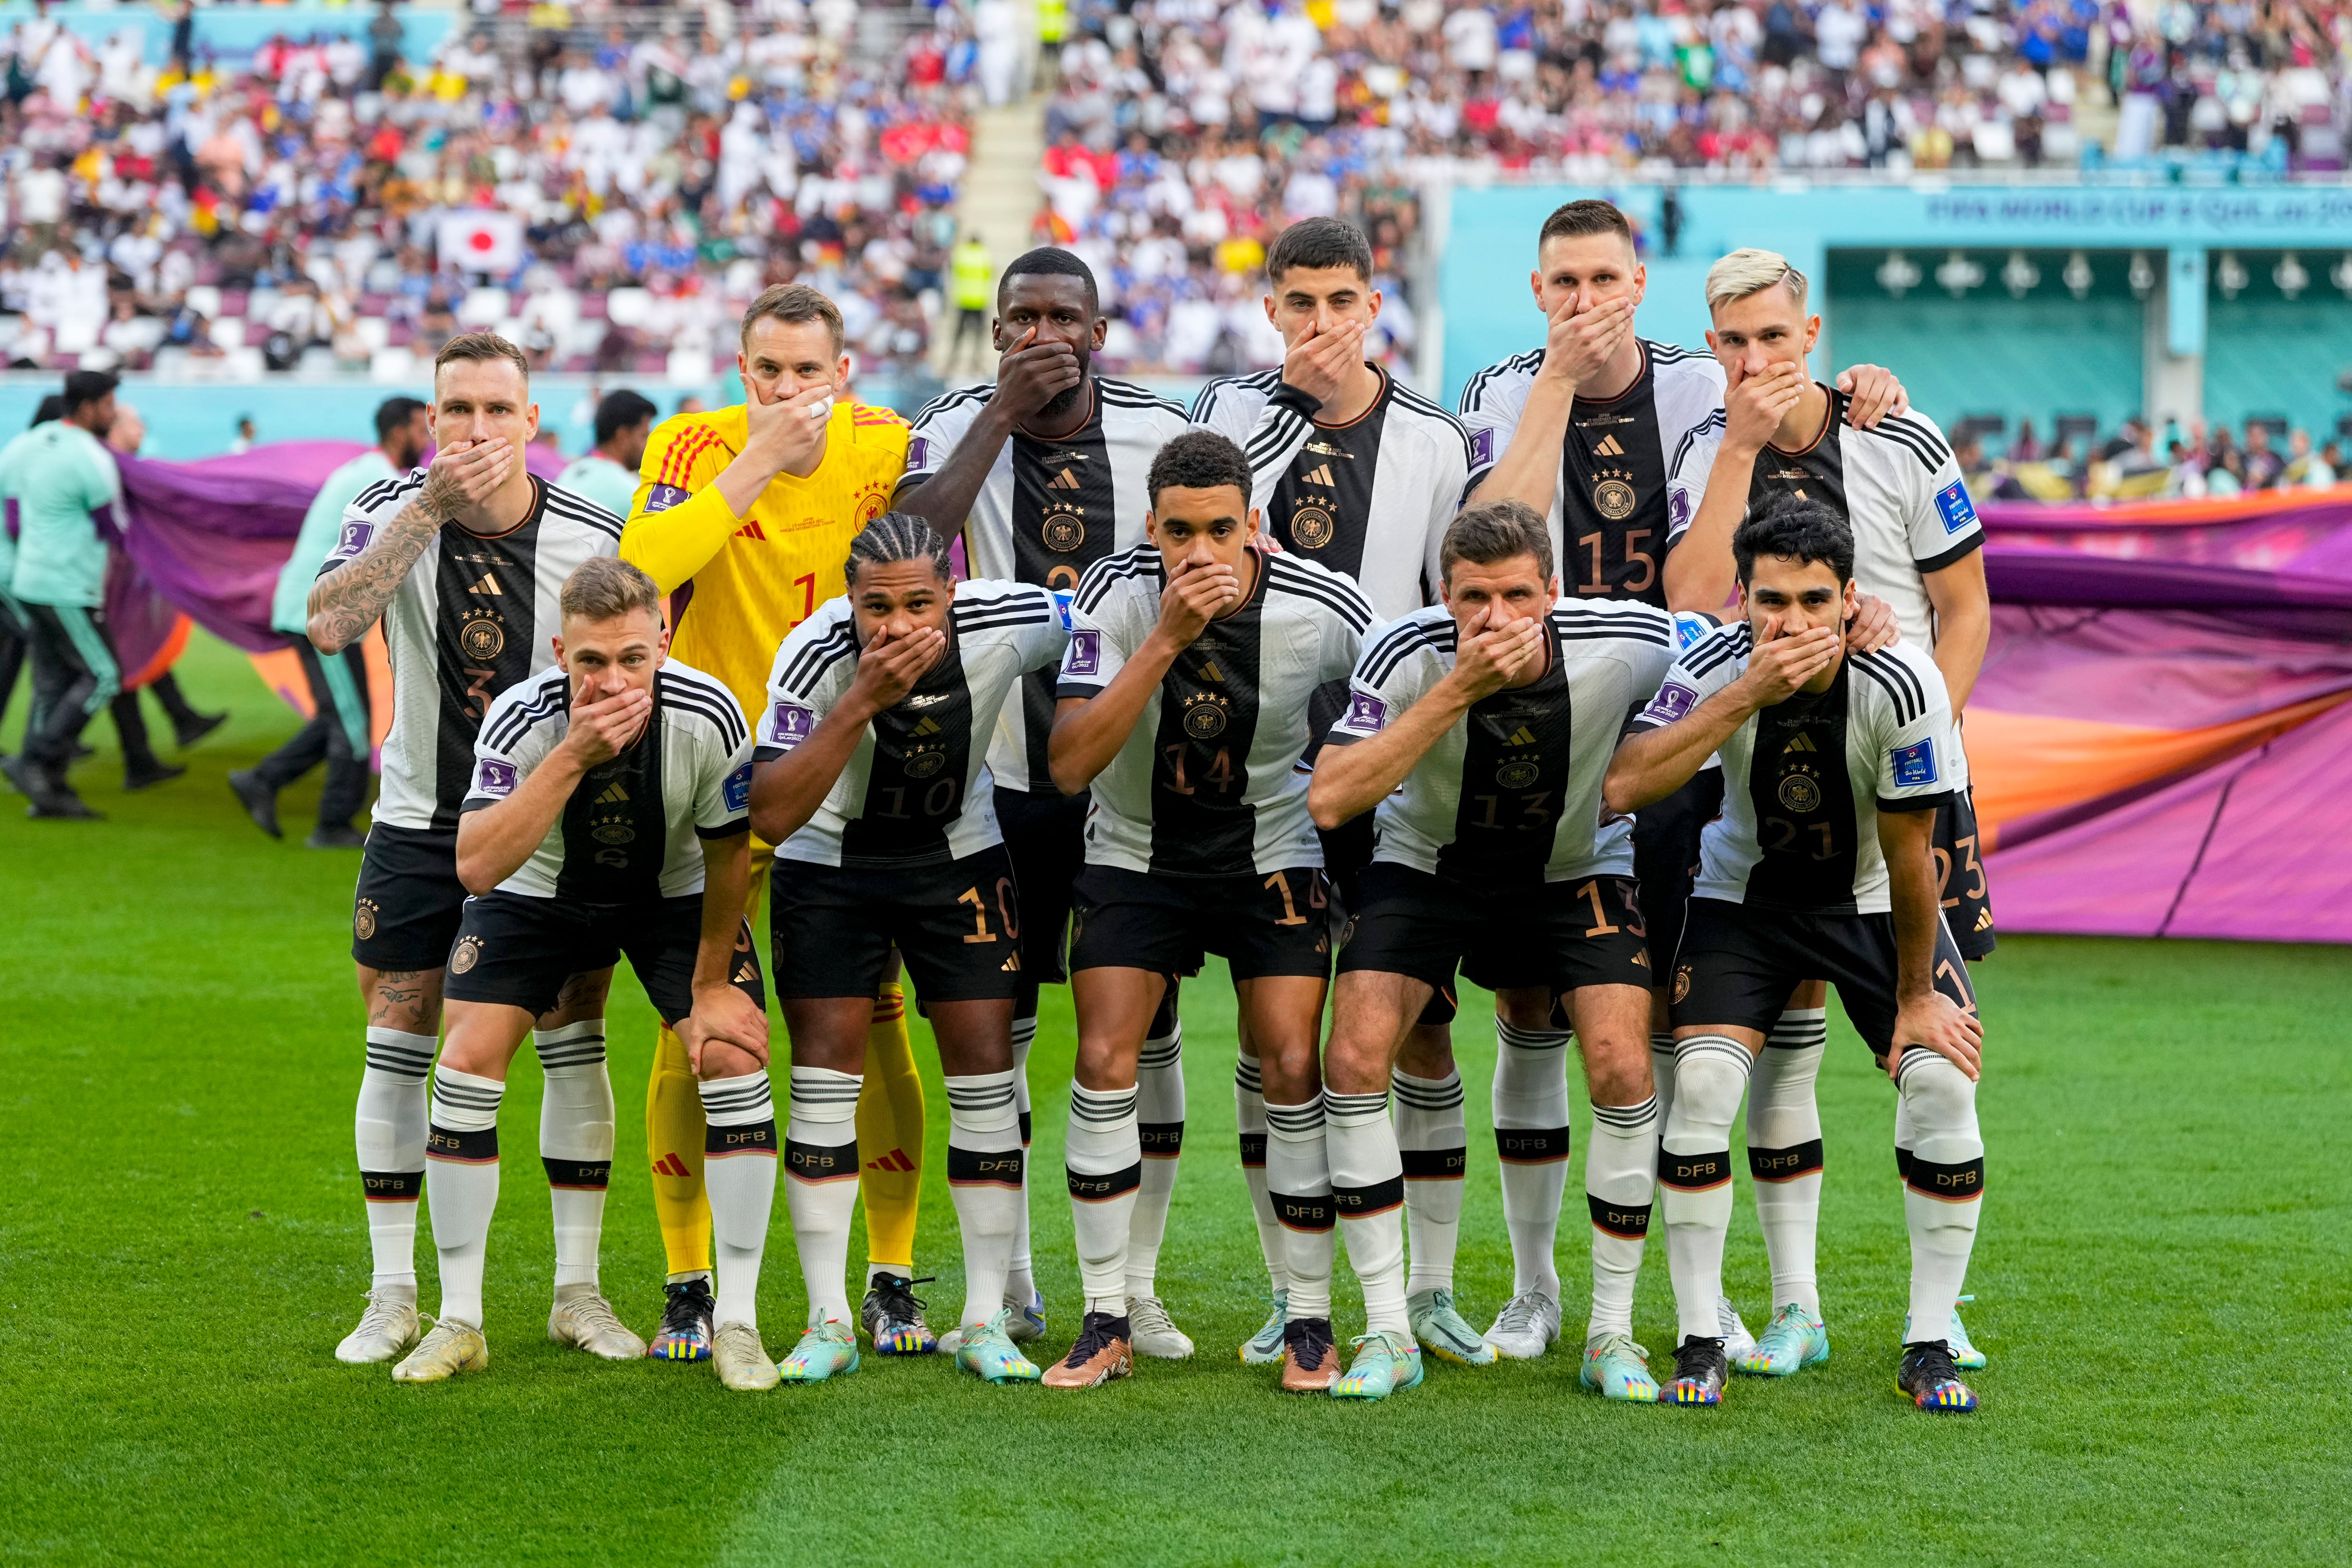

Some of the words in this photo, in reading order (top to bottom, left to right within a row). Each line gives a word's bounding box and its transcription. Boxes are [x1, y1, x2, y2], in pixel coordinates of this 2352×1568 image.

[862, 500, 881, 511] DEUTSCHER
[1949, 497, 1964, 509] FOOTBALL
[1951, 502, 1966, 515] UNITES
[1302, 512, 1325, 522] DEUTSCHER
[795, 523, 822, 531] INTERNATIONAL
[1579, 529, 1655, 593] 15
[789, 572, 815, 628] 1
[471, 625, 495, 634] DEUTSCHER
[463, 667, 496, 718] 3
[906, 700, 933, 711] INTERNATIONAL
[934, 694, 949, 704] STADIUM
[908, 699, 925, 708] NOVEMBER
[1163, 741, 1234, 795] 14
[1905, 757, 1923, 765] FOOTBALL
[1905, 762, 1924, 771] UNITES
[733, 779, 751, 789] FOOTBALL
[1788, 779, 1812, 788] DEUTSCHER
[876, 777, 956, 820] 10
[1470, 791, 1553, 830] 13
[1765, 816, 1843, 861] 21
[595, 848, 628, 869] 6
[1931, 834, 1986, 909] 23
[1263, 868, 1327, 925] 14
[957, 877, 1019, 943] 10
[1576, 879, 1646, 938] 13
[428, 1131, 460, 1149] DFB
[727, 1130, 766, 1144] DFB
[1141, 1132, 1179, 1144] DFB
[1506, 1138, 1547, 1151] DFB
[1240, 1143, 1267, 1153] DF
[792, 1152, 834, 1168] DFB
[979, 1160, 1019, 1172] DFB
[1446, 1155, 1466, 1167] DF
[1758, 1154, 1799, 1169] DFB
[1677, 1162, 1716, 1177] DFB
[366, 1178, 405, 1189] DFB
[1069, 1177, 1110, 1192] DFB
[1937, 1170, 1976, 1187] DFB
[1287, 1204, 1324, 1219] DFB
[1609, 1211, 1646, 1226] DFB
